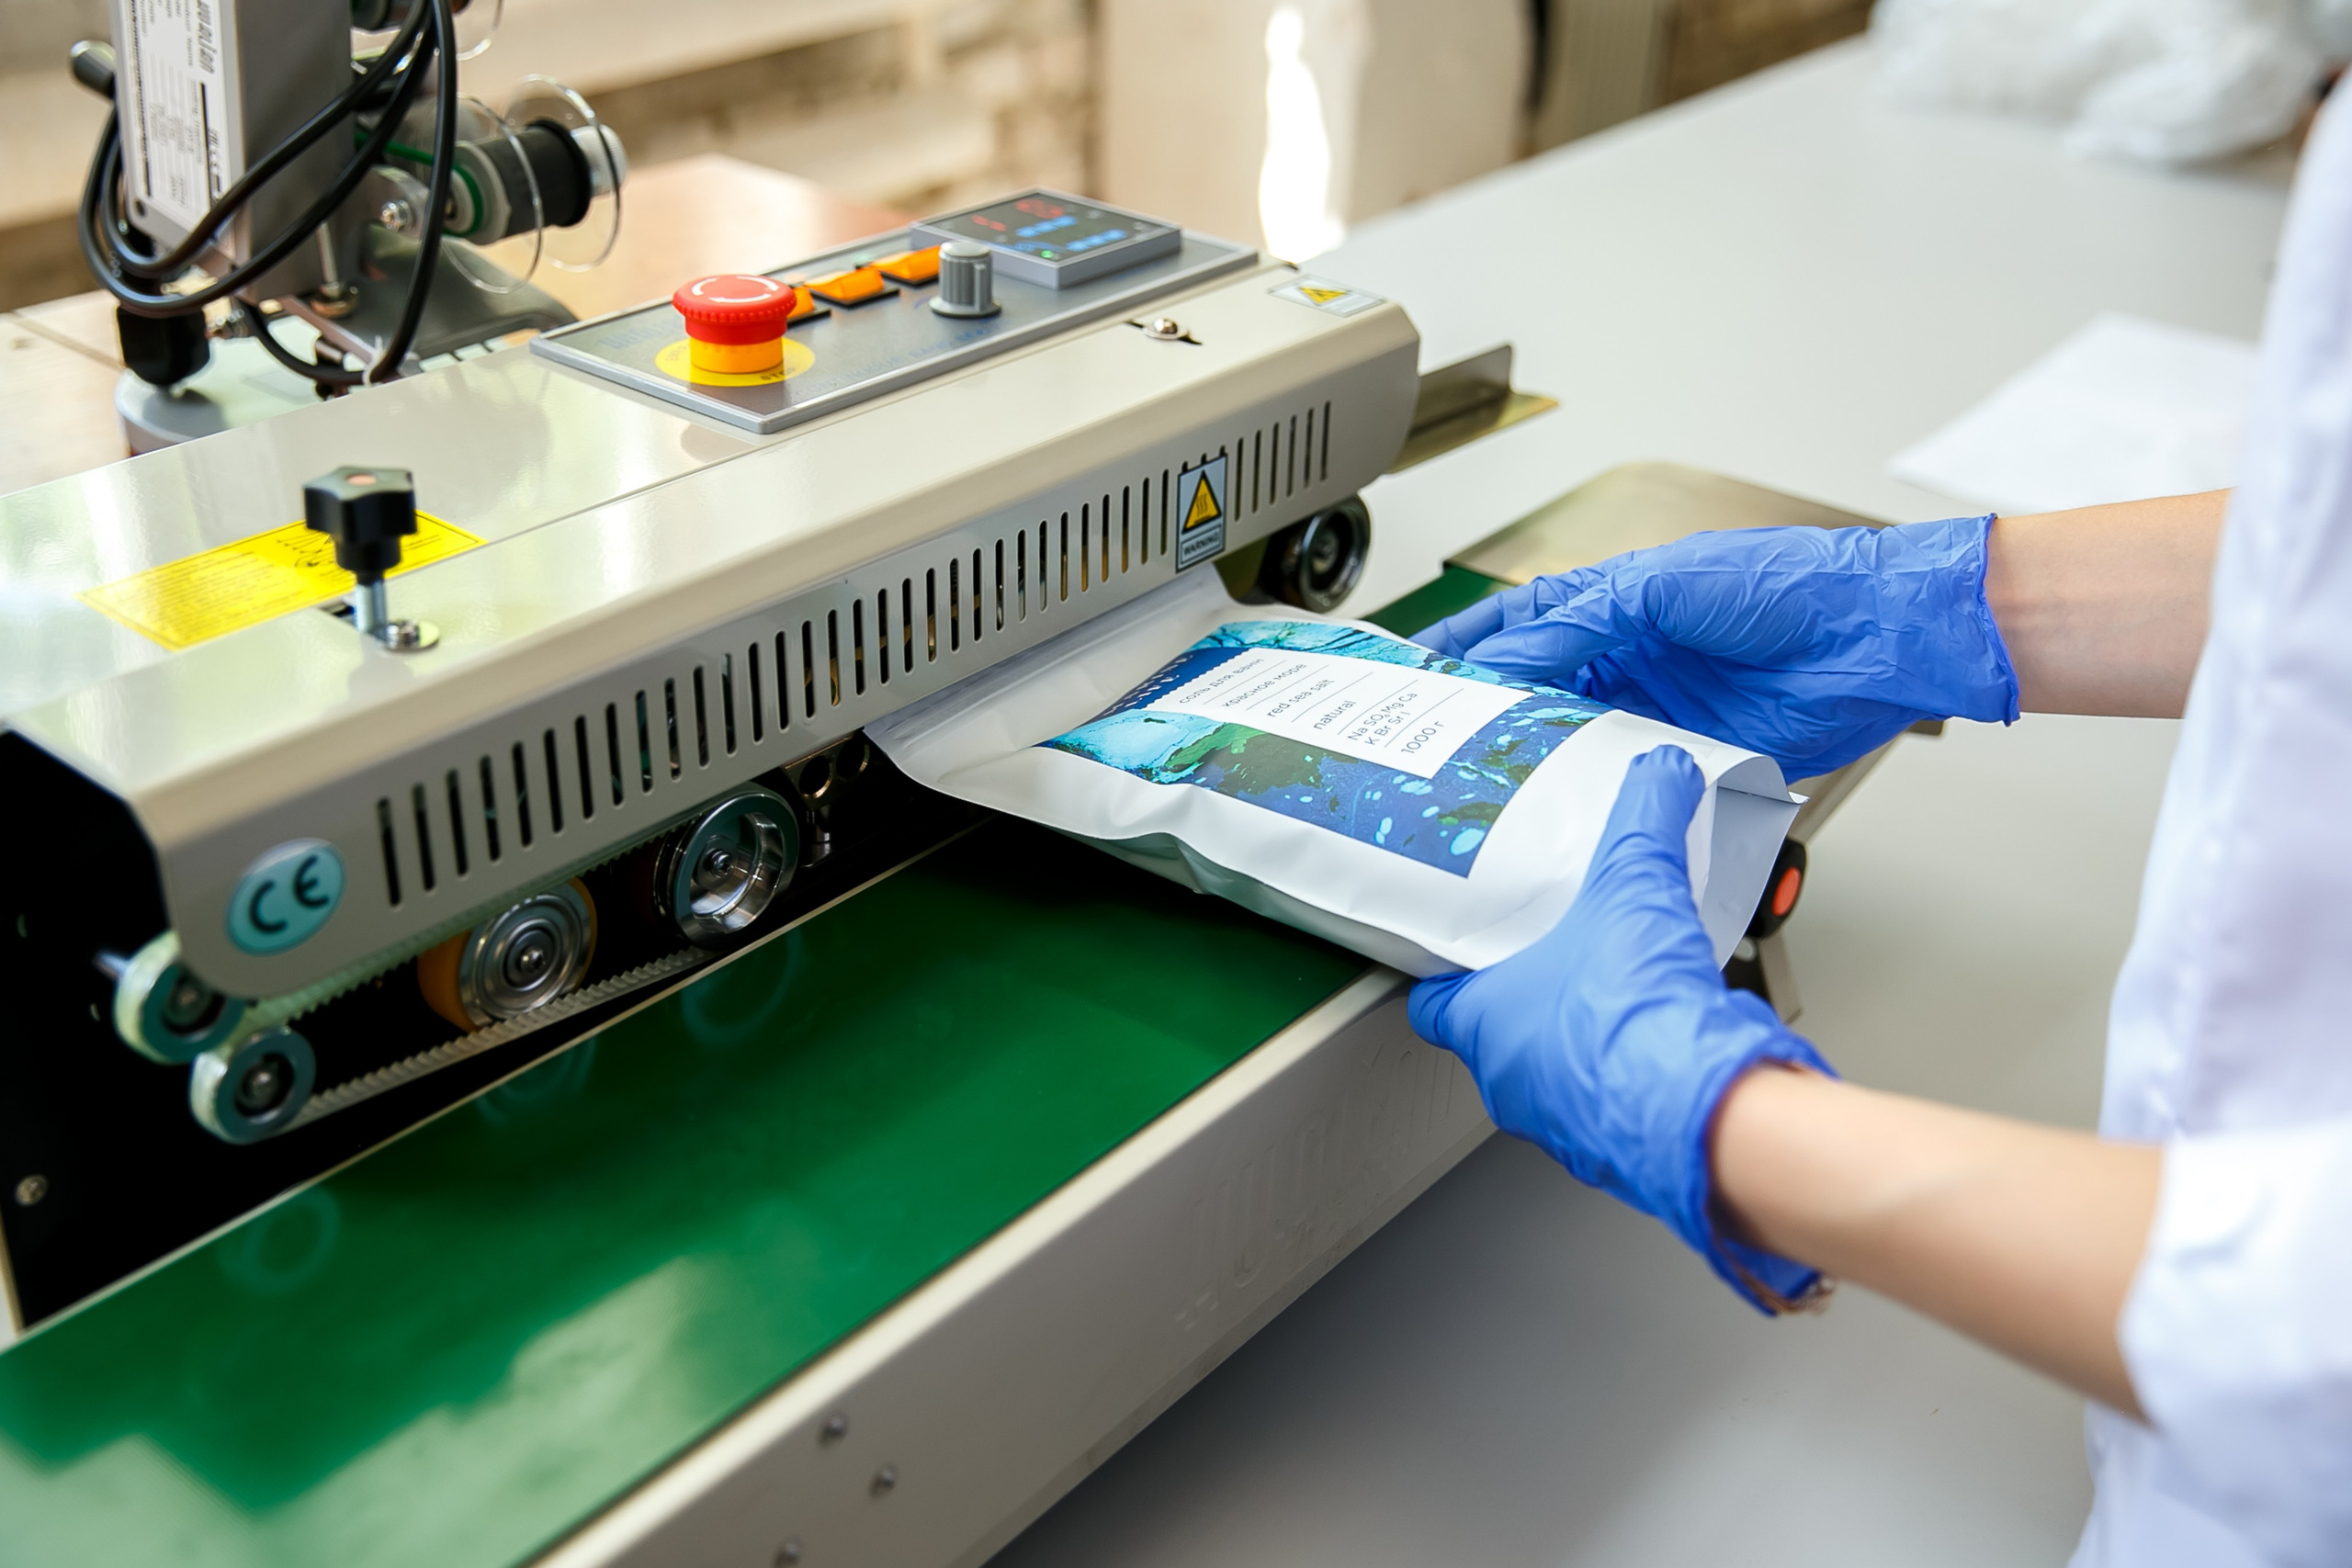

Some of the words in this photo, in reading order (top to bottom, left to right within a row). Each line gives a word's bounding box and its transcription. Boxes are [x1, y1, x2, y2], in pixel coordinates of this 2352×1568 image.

[1179, 687, 1211, 704] соль
[1209, 673, 1235, 688] для
[1233, 658, 1264, 674] ванн
[1221, 680, 1275, 707] красное
[1273, 663, 1306, 681] море
[1267, 702, 1291, 717] red
[1289, 689, 1312, 704] sea
[1310, 679, 1335, 693] salt
[1313, 700, 1357, 730] natural
[1347, 727, 1369, 741] Na
[1398, 692, 1418, 703] Ca
[1364, 737, 1380, 746] K
[1374, 725, 1392, 737] Br
[1387, 715, 1405, 726] Sr
[1401, 727, 1437, 754] 1000
[248, 853, 331, 934] CE
